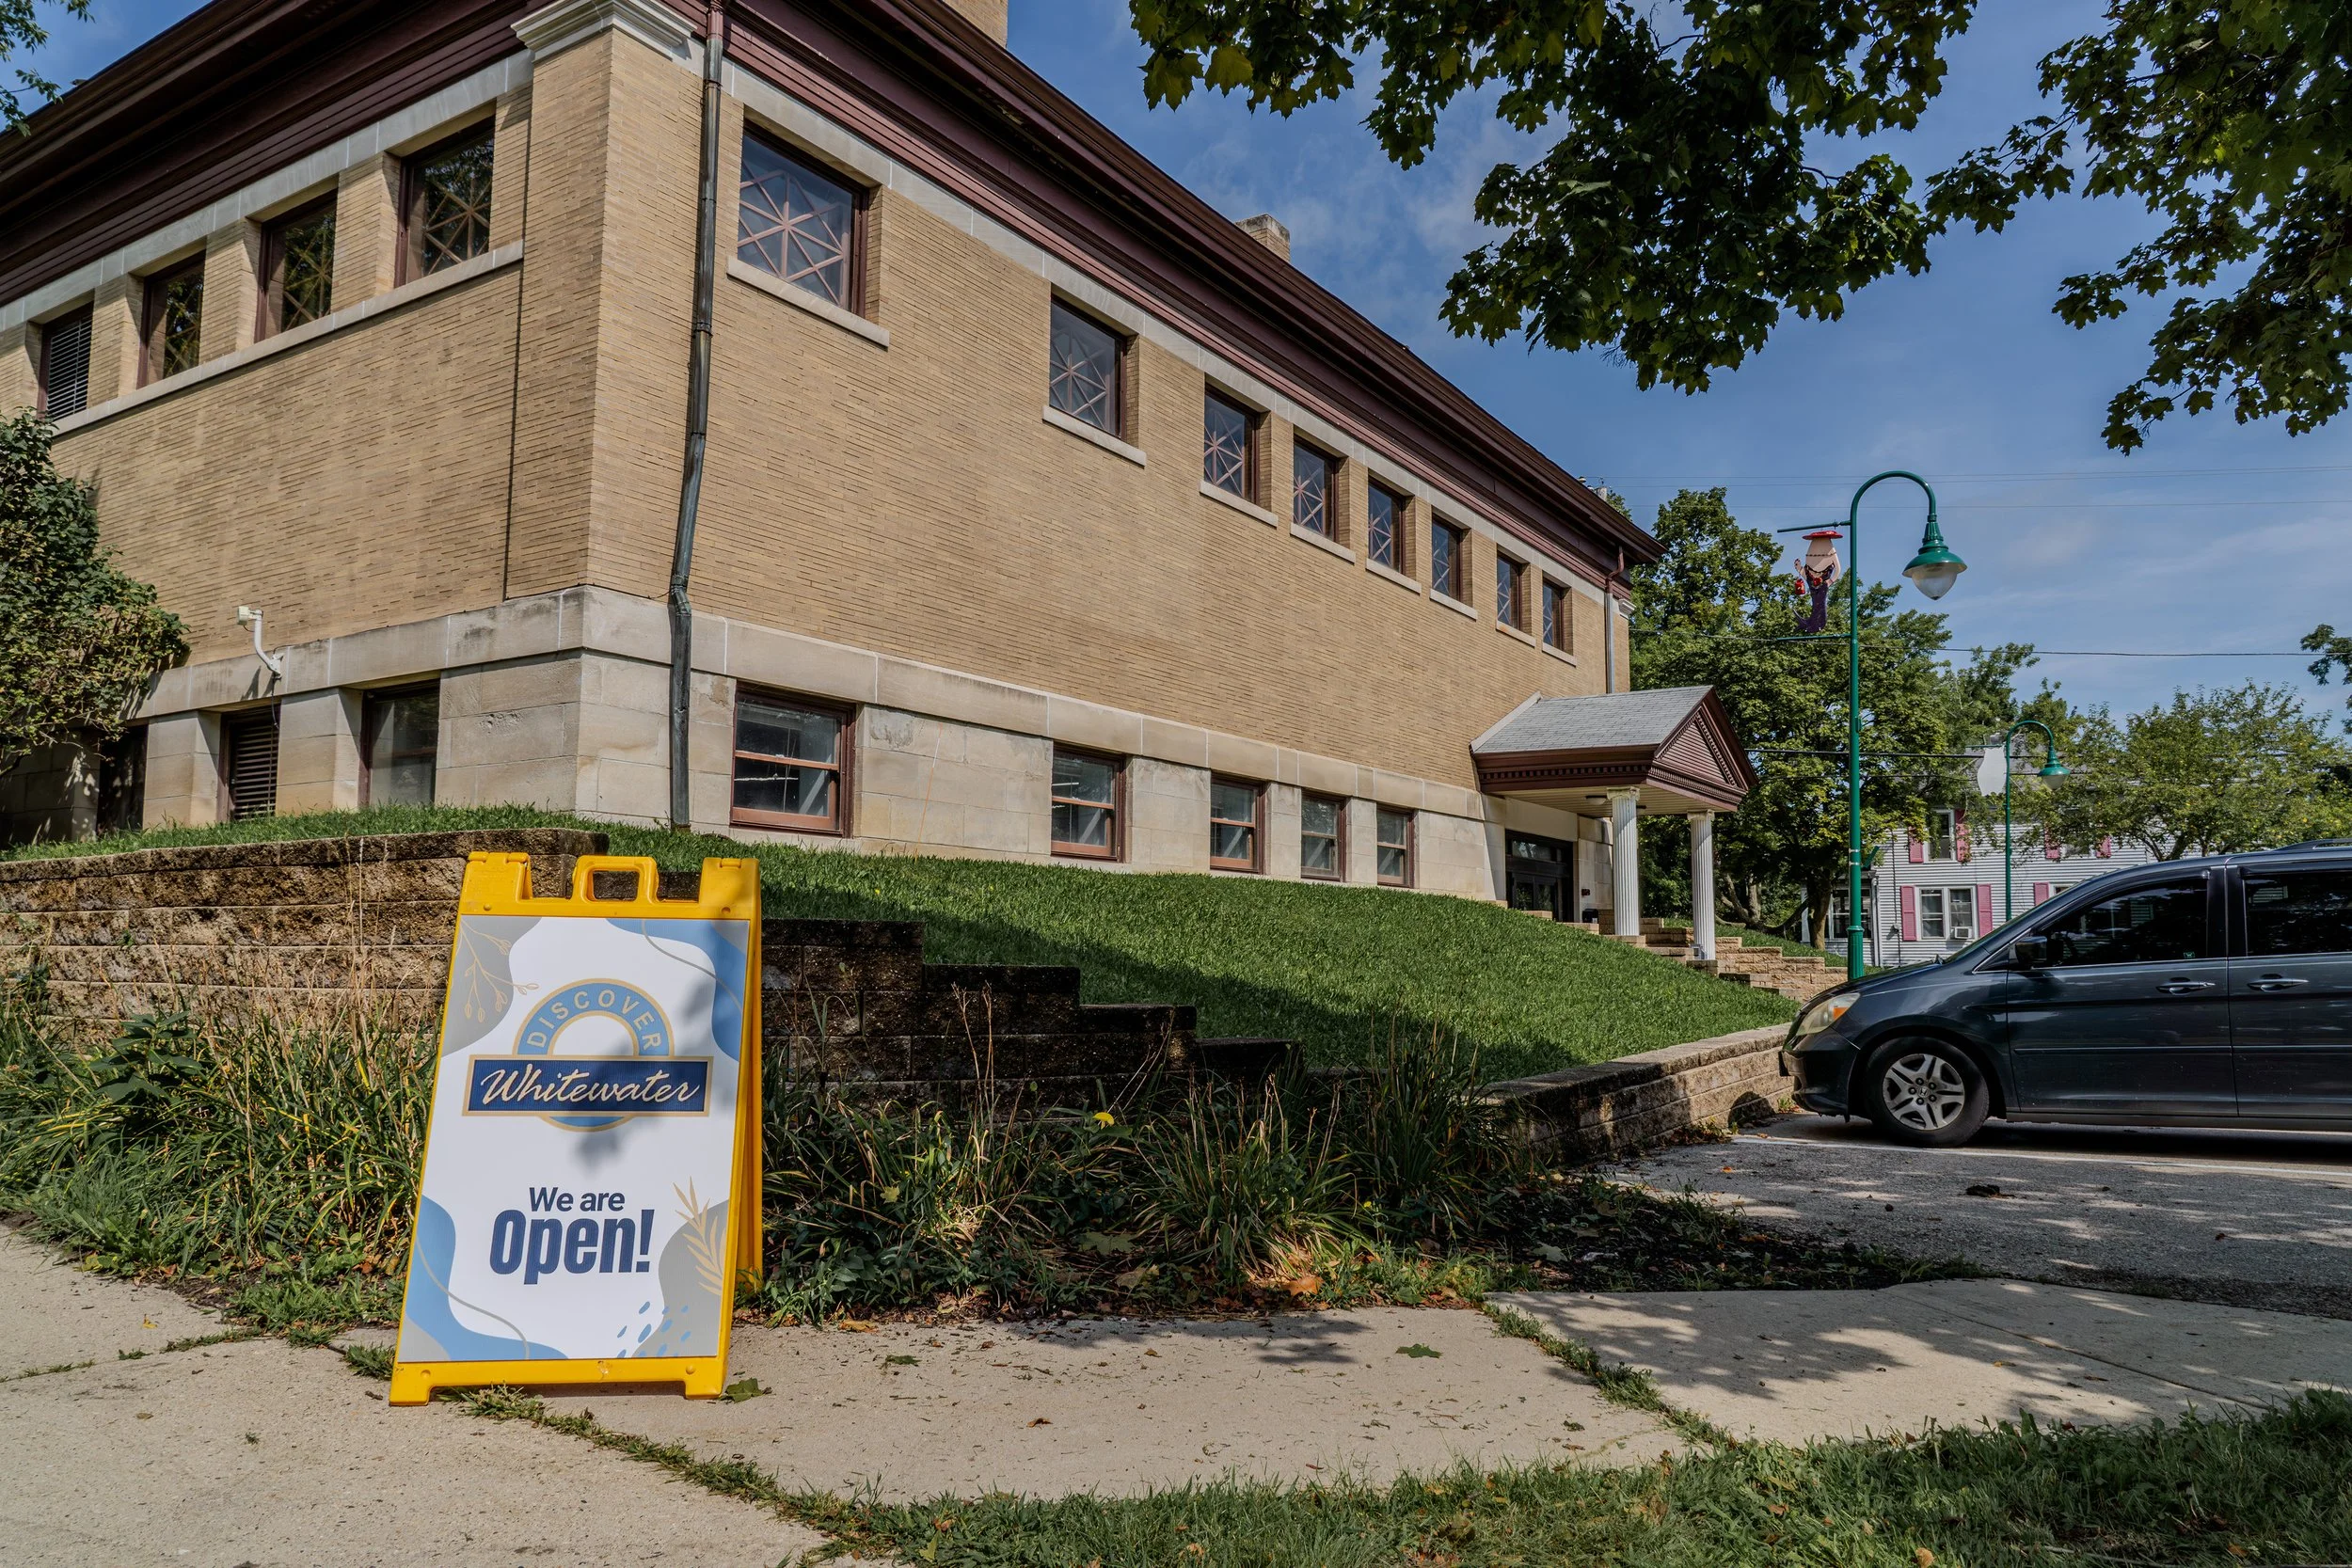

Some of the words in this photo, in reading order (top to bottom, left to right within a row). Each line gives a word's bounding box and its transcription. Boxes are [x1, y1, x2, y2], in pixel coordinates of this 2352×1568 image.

[526, 989, 662, 1051] DISCOVER
[480, 1063, 700, 1105] Whitewater
[529, 1186, 574, 1212] We
[580, 1192, 626, 1212] are
[489, 1209, 656, 1286] Open!
